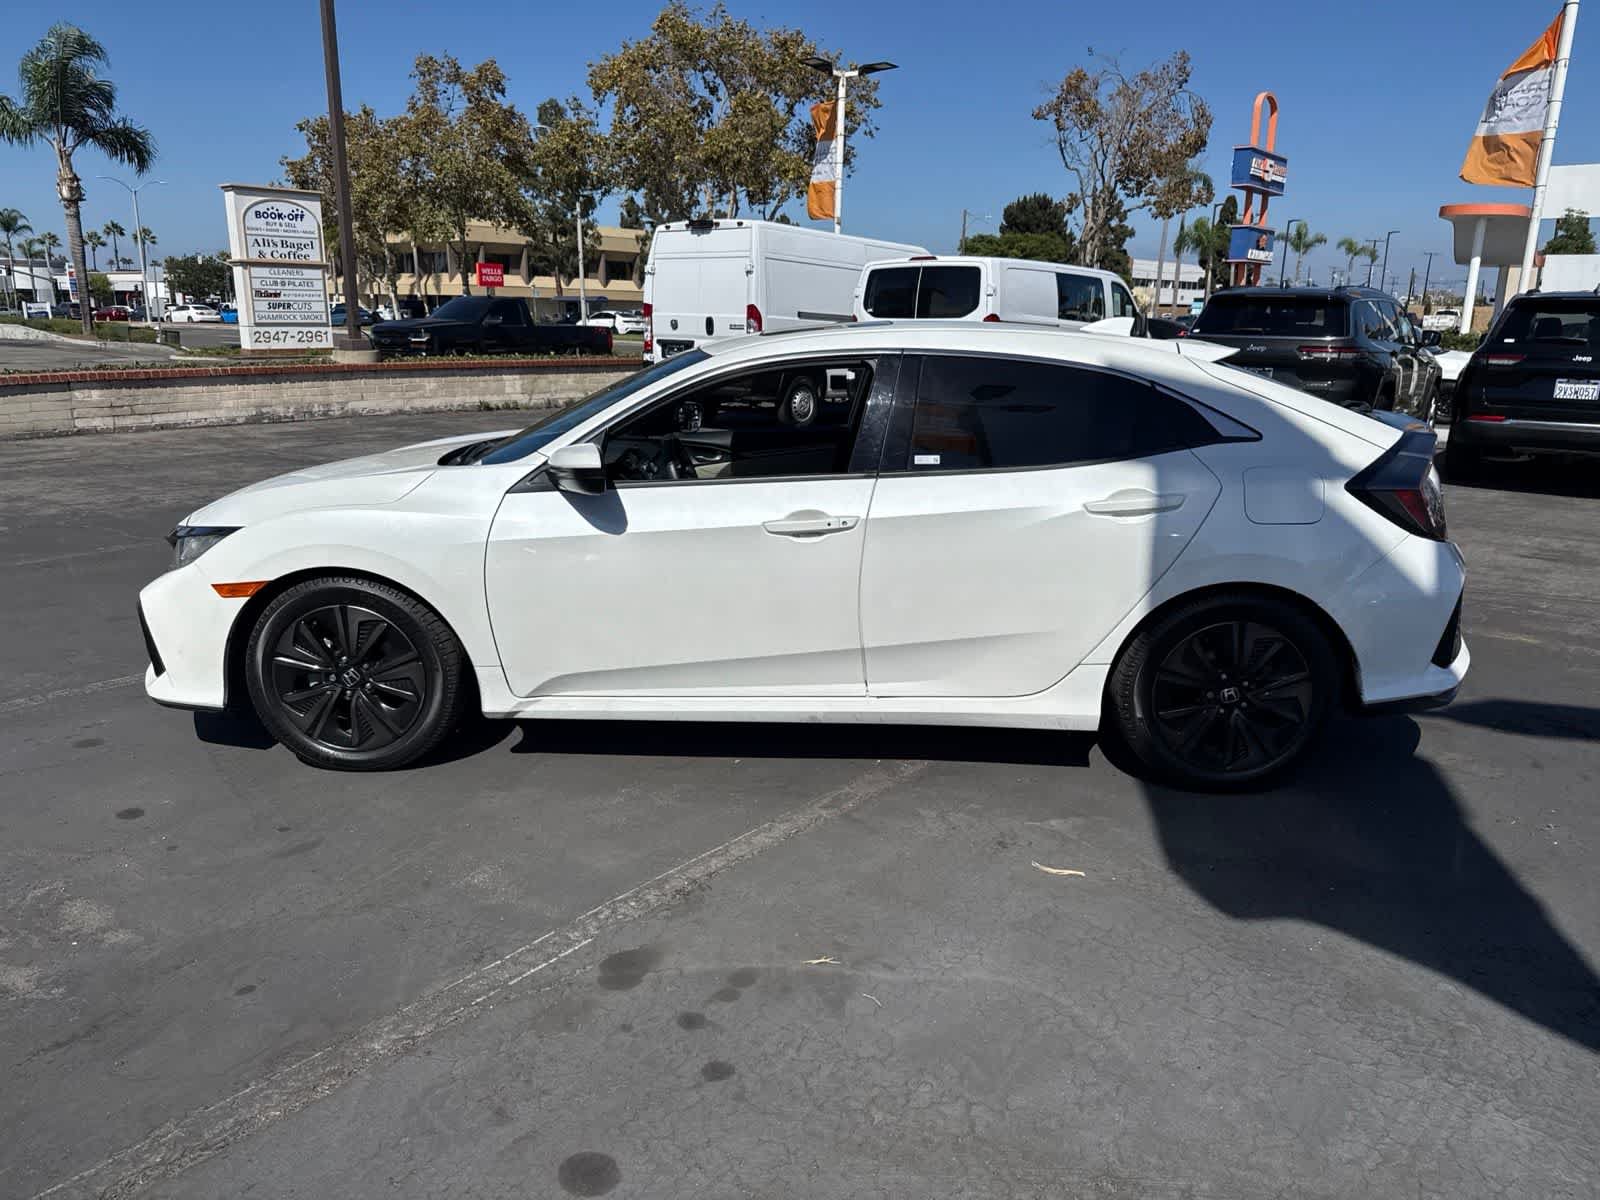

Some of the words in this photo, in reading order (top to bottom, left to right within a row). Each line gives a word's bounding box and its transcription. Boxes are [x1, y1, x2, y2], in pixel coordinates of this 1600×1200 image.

[251, 238, 279, 248] Ali's
[281, 239, 315, 251] Bagel
[258, 249, 267, 259] &
[270, 250, 311, 260] Coffee
[268, 268, 304, 277] CLEANERS
[267, 302, 313, 311] SUPERCUTS
[257, 312, 297, 321] SHAMROCK
[299, 313, 324, 321] SMOKE
[253, 330, 329, 344] 2947-2961
[1572, 354, 1593, 363] Jeep
